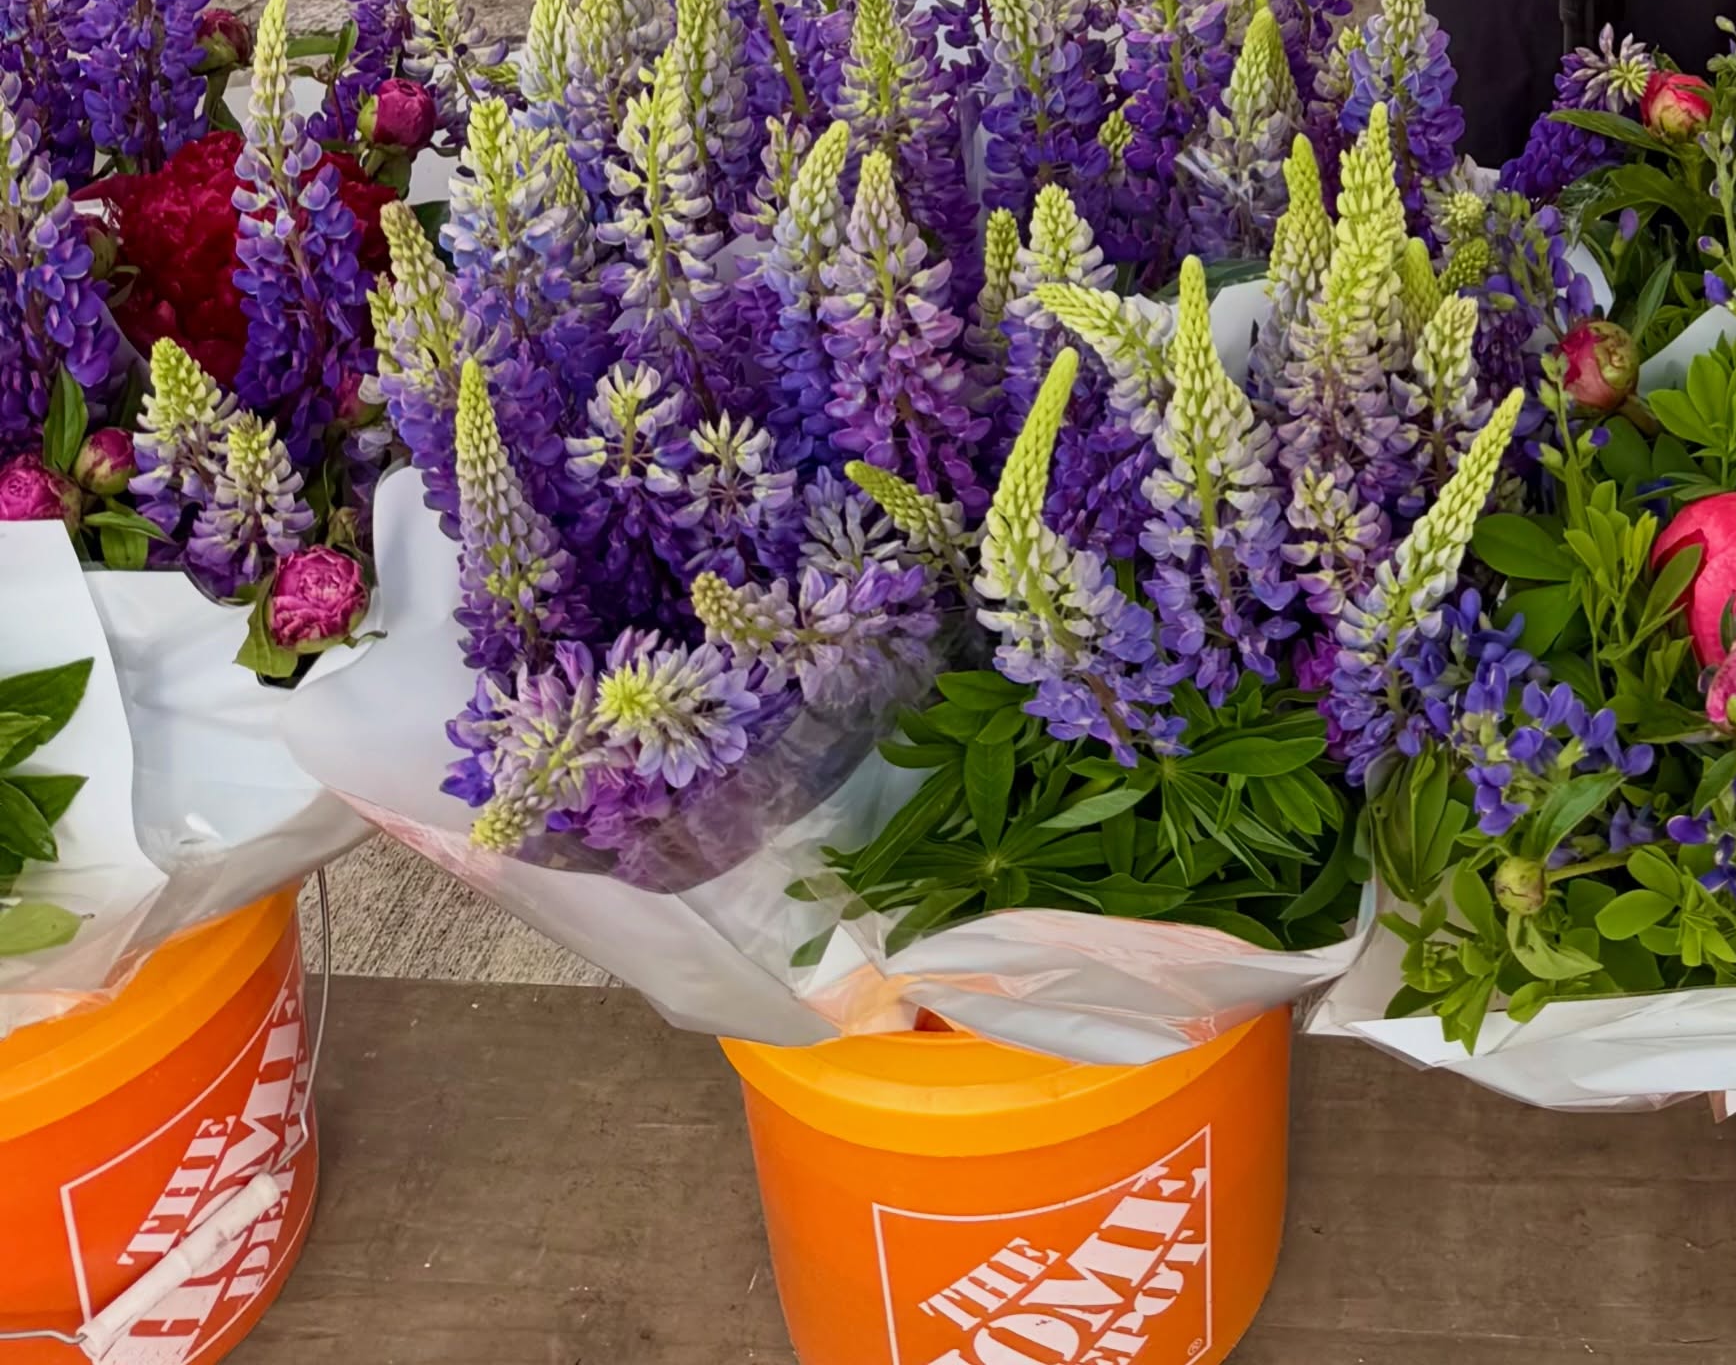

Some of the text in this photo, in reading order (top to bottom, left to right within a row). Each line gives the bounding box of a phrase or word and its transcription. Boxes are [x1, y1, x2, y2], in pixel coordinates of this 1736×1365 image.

[116, 1115, 237, 1266] THE
[928, 1165, 1207, 1365] OME
[917, 1236, 1062, 1332] THE
